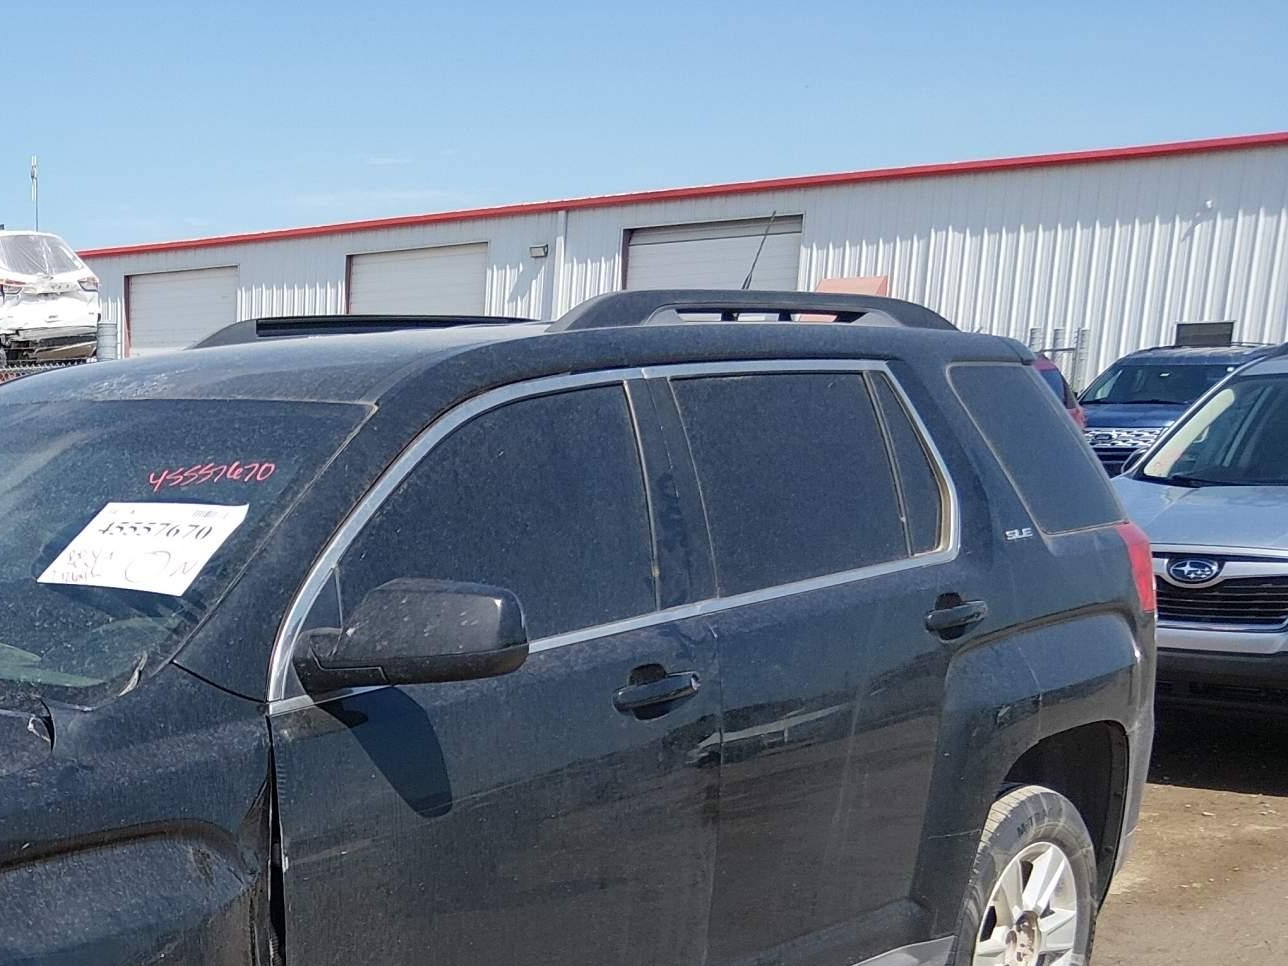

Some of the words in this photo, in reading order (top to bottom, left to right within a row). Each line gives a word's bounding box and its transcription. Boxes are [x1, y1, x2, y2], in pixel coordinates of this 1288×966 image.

[149, 460, 276, 492] 45557670
[97, 521, 213, 541] 45557670
[1005, 527, 1033, 540] SLE
